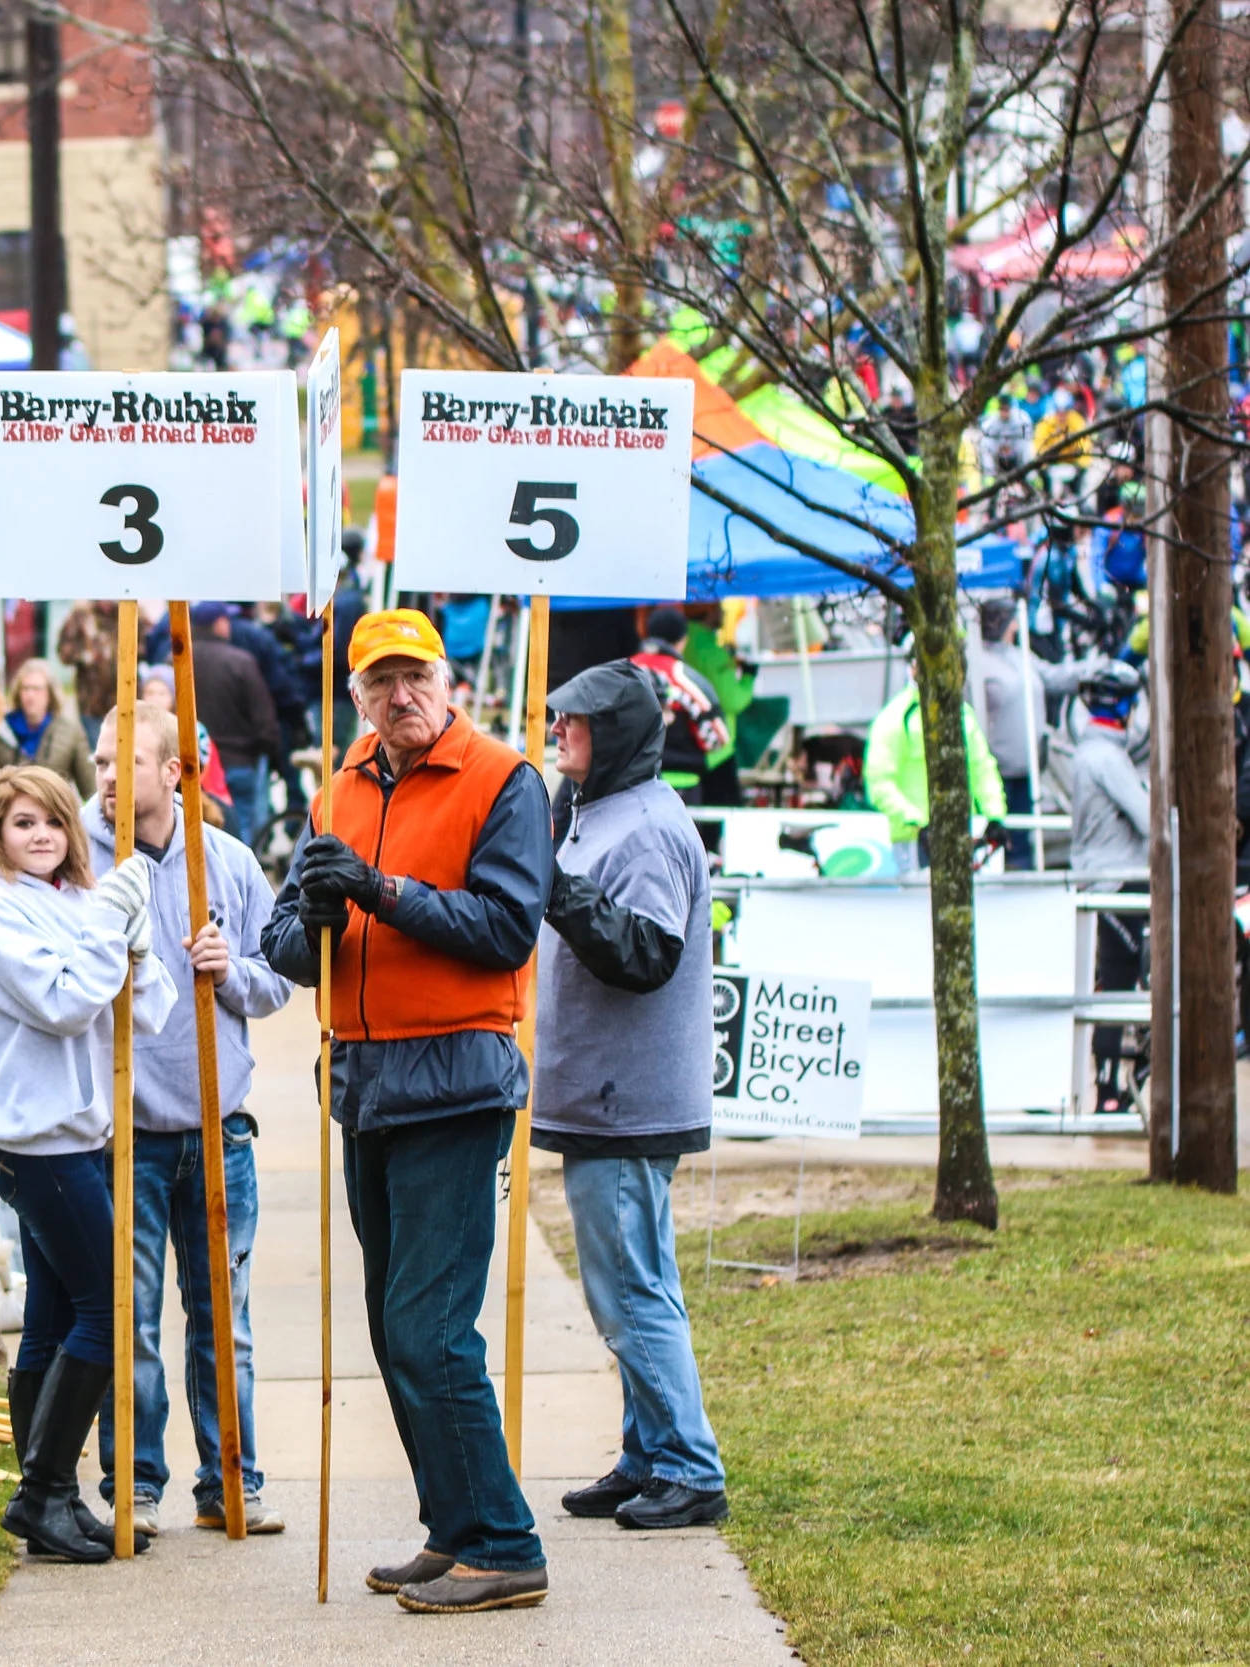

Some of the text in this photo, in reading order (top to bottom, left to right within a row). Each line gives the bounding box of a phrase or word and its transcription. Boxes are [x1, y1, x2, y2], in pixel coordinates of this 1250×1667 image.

[0, 390, 258, 428] Barry-Roubaix
[421, 390, 668, 431] Barry-Roubaix
[2, 422, 258, 443] Killer Gravel Road Race
[422, 422, 667, 450] Killer Gravel Road Race
[98, 484, 165, 565] 3
[505, 480, 580, 562] 5
[754, 980, 837, 1014] Main
[752, 1011, 846, 1045] Street
[750, 1042, 860, 1082] Bicycle
[746, 1073, 798, 1104] Co.
[714, 1107, 857, 1131] nStreetBicycleCo.com
